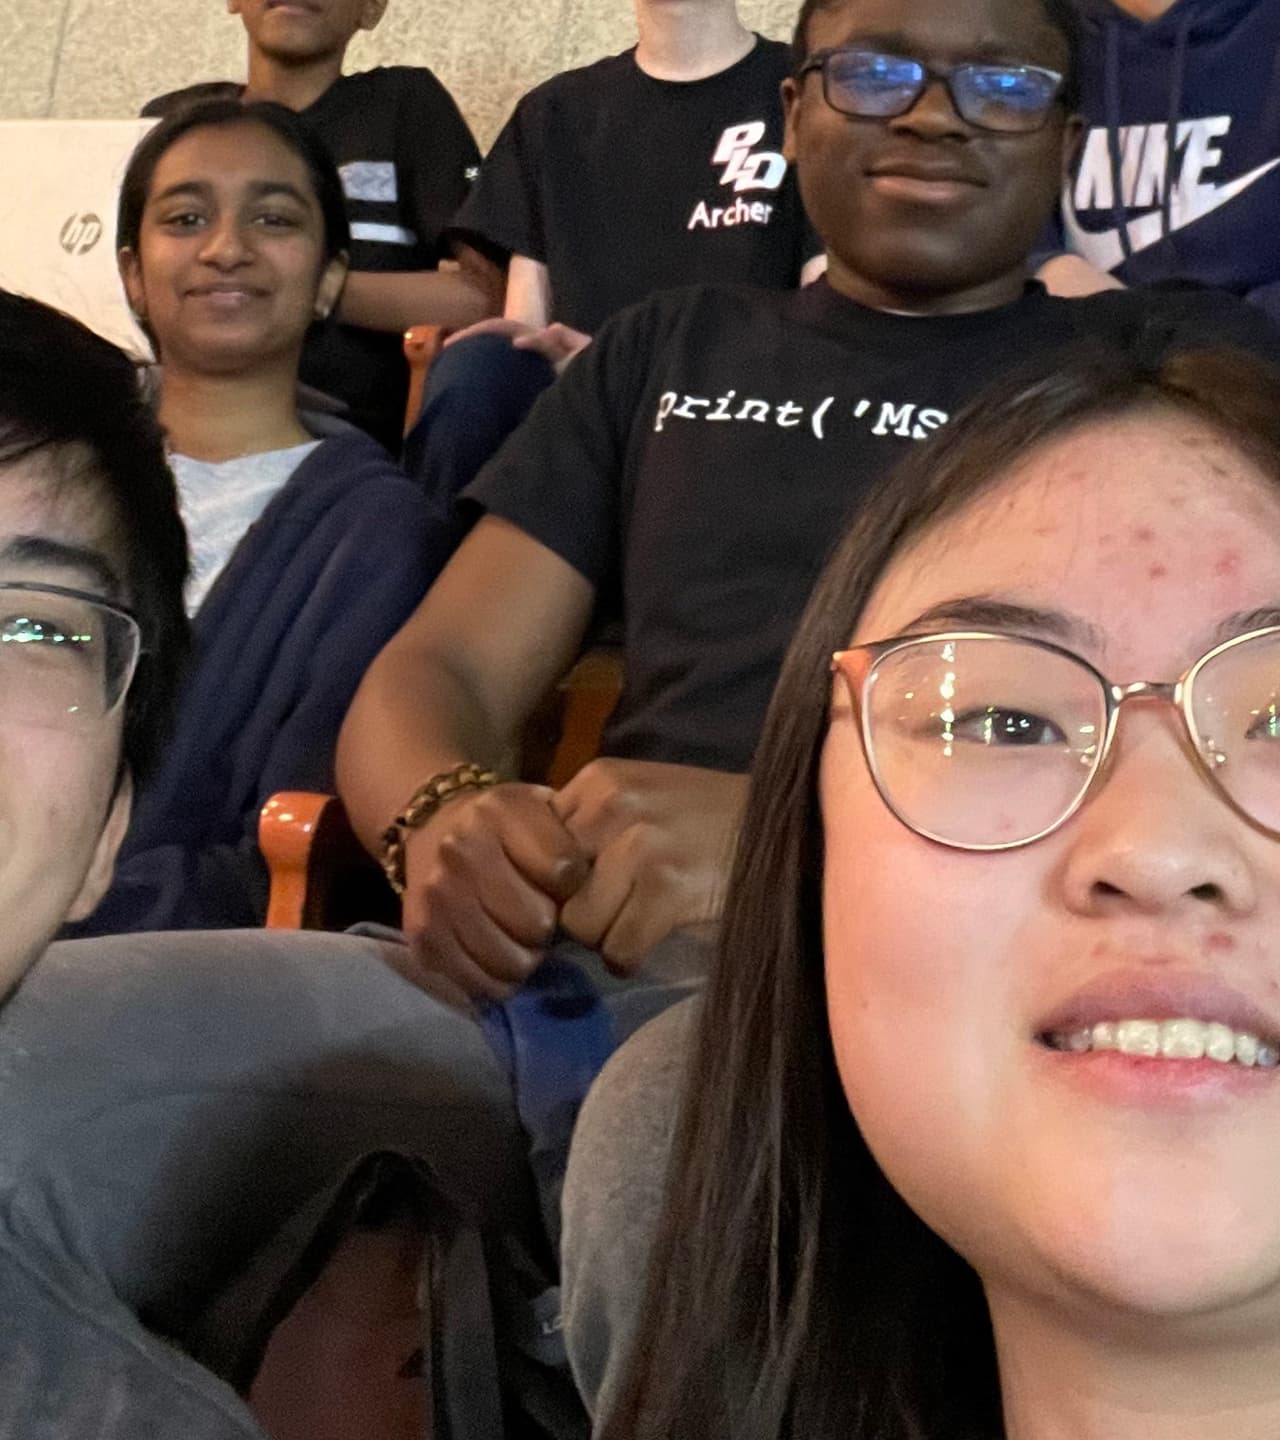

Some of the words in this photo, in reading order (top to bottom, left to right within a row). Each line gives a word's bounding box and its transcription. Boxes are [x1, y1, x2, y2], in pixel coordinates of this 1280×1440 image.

[1074, 116, 1232, 210] NIKE
[59, 212, 102, 256] hp
[687, 197, 774, 230] Archer
